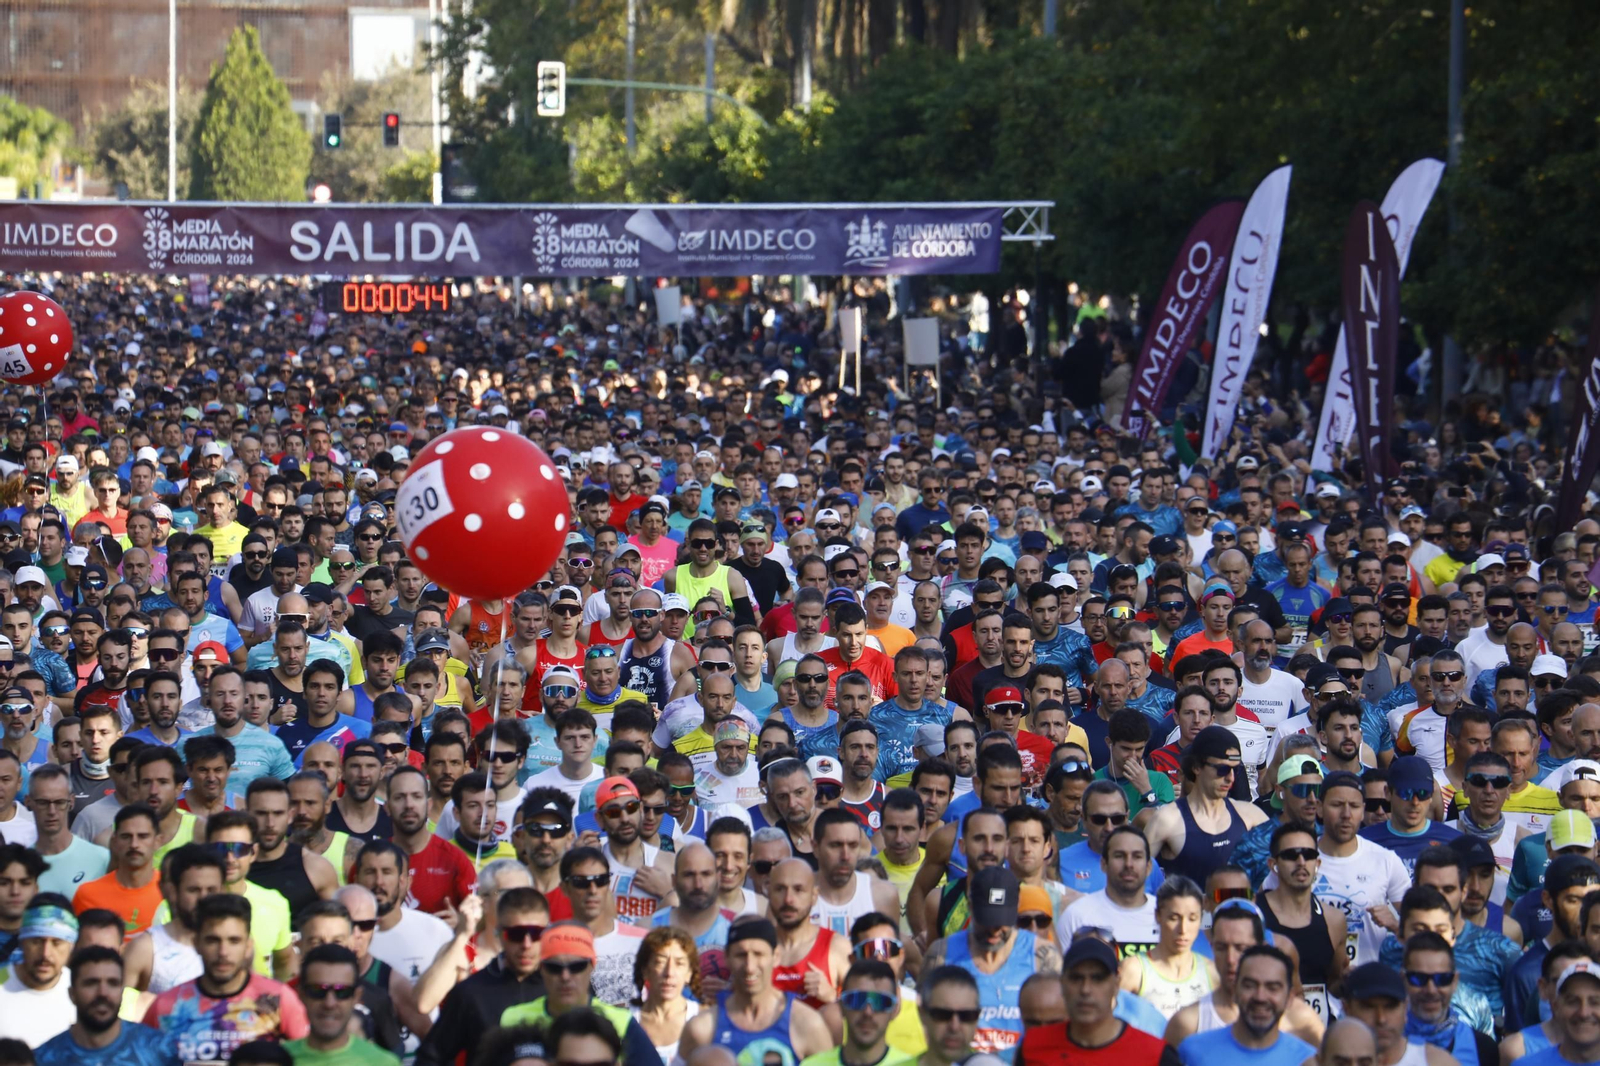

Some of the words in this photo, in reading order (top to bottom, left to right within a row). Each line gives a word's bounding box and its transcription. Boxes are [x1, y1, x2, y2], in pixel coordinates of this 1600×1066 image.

[4, 222, 118, 247] IMDECO
[172, 219, 223, 235] MEDIA
[560, 223, 610, 239] MEDIA
[892, 222, 993, 241] AYUNTAMIENTO
[142, 229, 172, 251] 38
[173, 230, 254, 251] MARATÓN
[289, 220, 481, 262] SALIDA
[531, 234, 560, 256] 38
[561, 234, 640, 255] MARATÓN
[709, 229, 816, 251] IMDECO
[892, 241, 910, 258] DE
[911, 239, 976, 258] CÓRDOBA
[50, 250, 84, 259] Deportes
[172, 252, 222, 265] CÓRDOBA
[226, 253, 254, 265] 2024
[560, 256, 609, 268] CÓRDOBA
[613, 257, 640, 268] 2024
[343, 283, 449, 313] 00:00:44
[1137, 240, 1211, 399] IMDECO
[399, 486, 439, 535] 1:30
